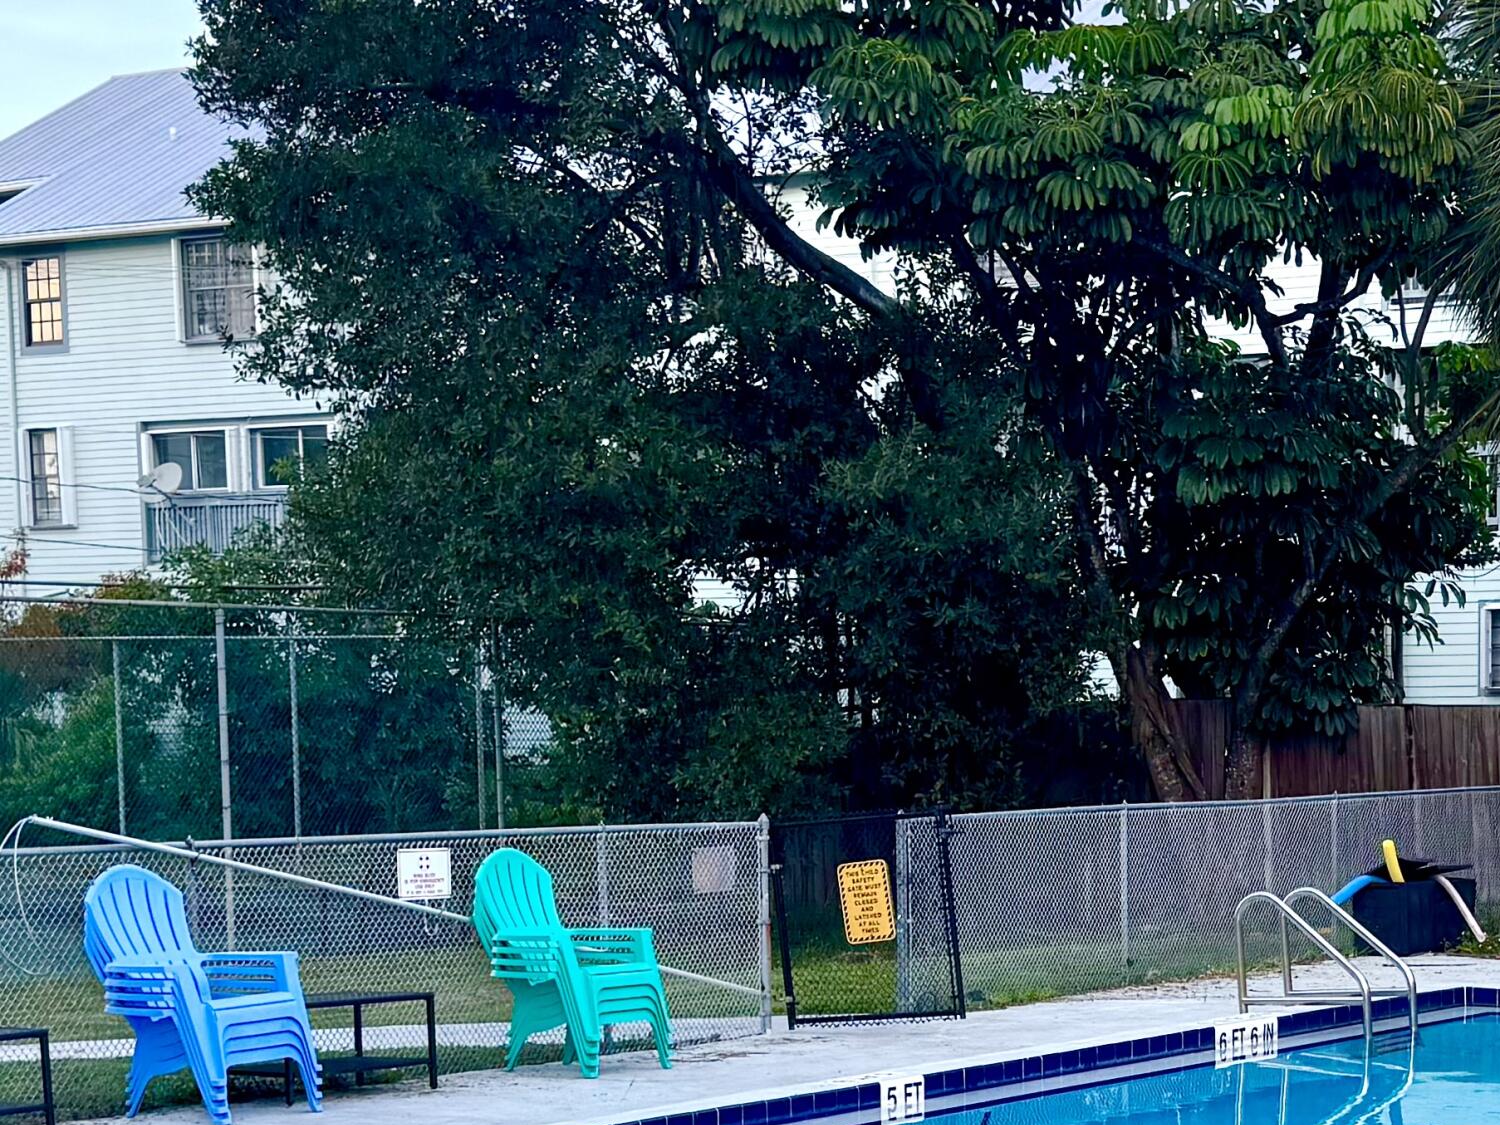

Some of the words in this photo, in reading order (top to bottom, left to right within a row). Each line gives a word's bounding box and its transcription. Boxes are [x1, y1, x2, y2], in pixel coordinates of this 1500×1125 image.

[852, 876, 875, 884] SAFETY
[854, 898, 878, 906] CLOSED
[855, 912, 882, 920] LATCHED
[1263, 1022, 1274, 1050] IN
[887, 1086, 897, 1112] 5
